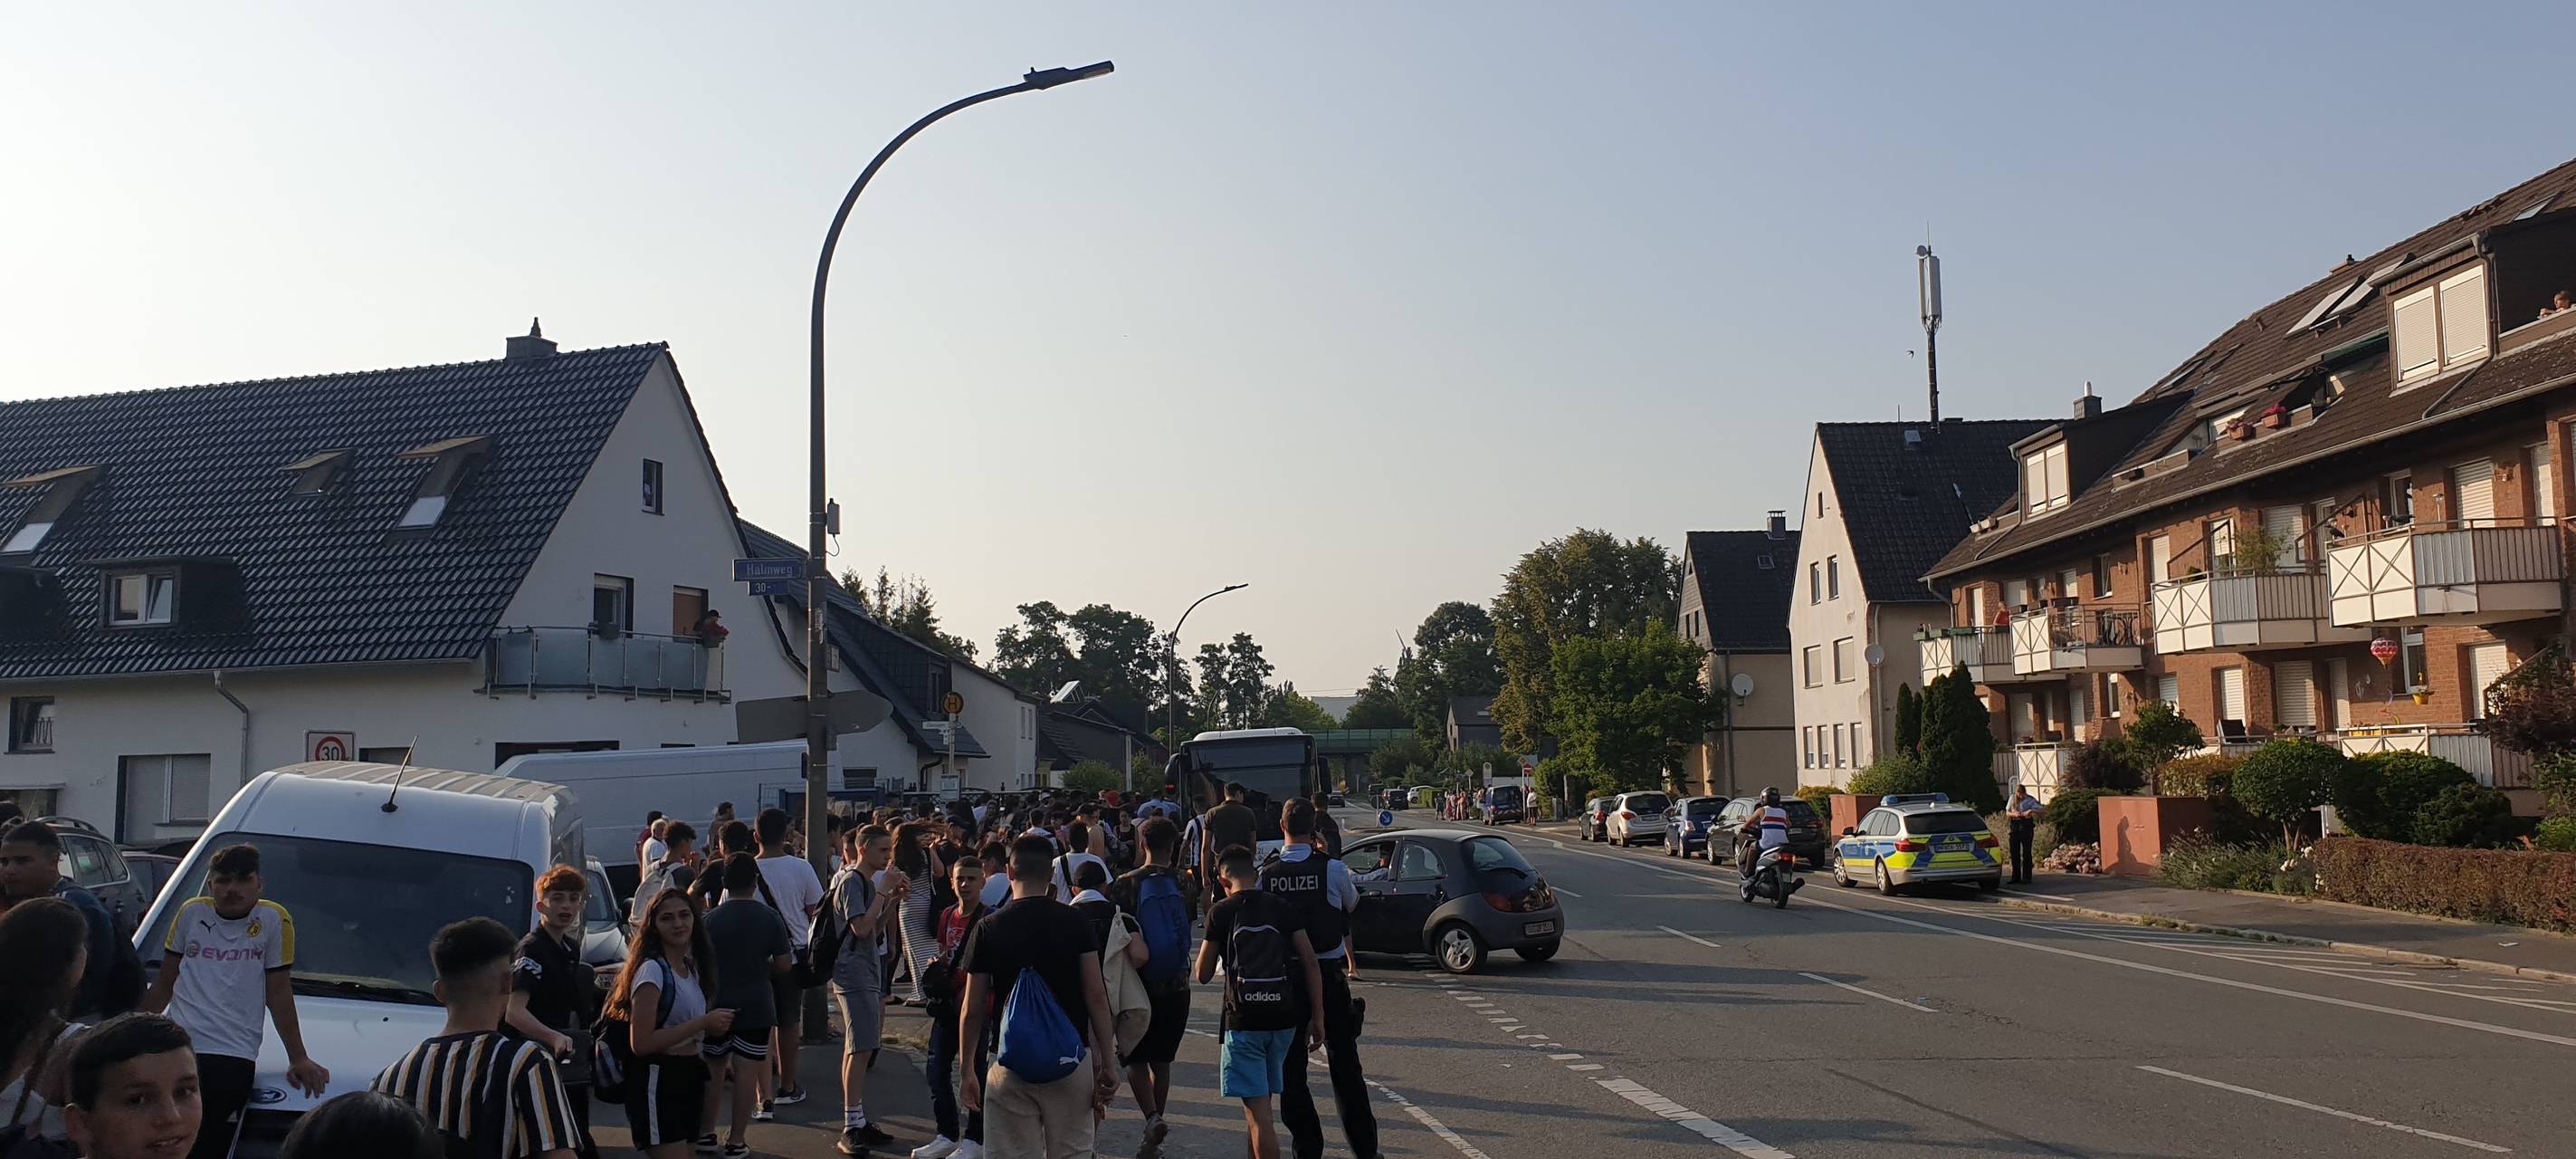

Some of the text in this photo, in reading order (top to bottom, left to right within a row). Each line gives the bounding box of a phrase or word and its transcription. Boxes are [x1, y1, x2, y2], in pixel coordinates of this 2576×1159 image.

[746, 562, 793, 577] Halmweg
[321, 746, 339, 761] 30
[1270, 875, 1319, 892] POLIZEI
[1245, 991, 1282, 1001] adidas
